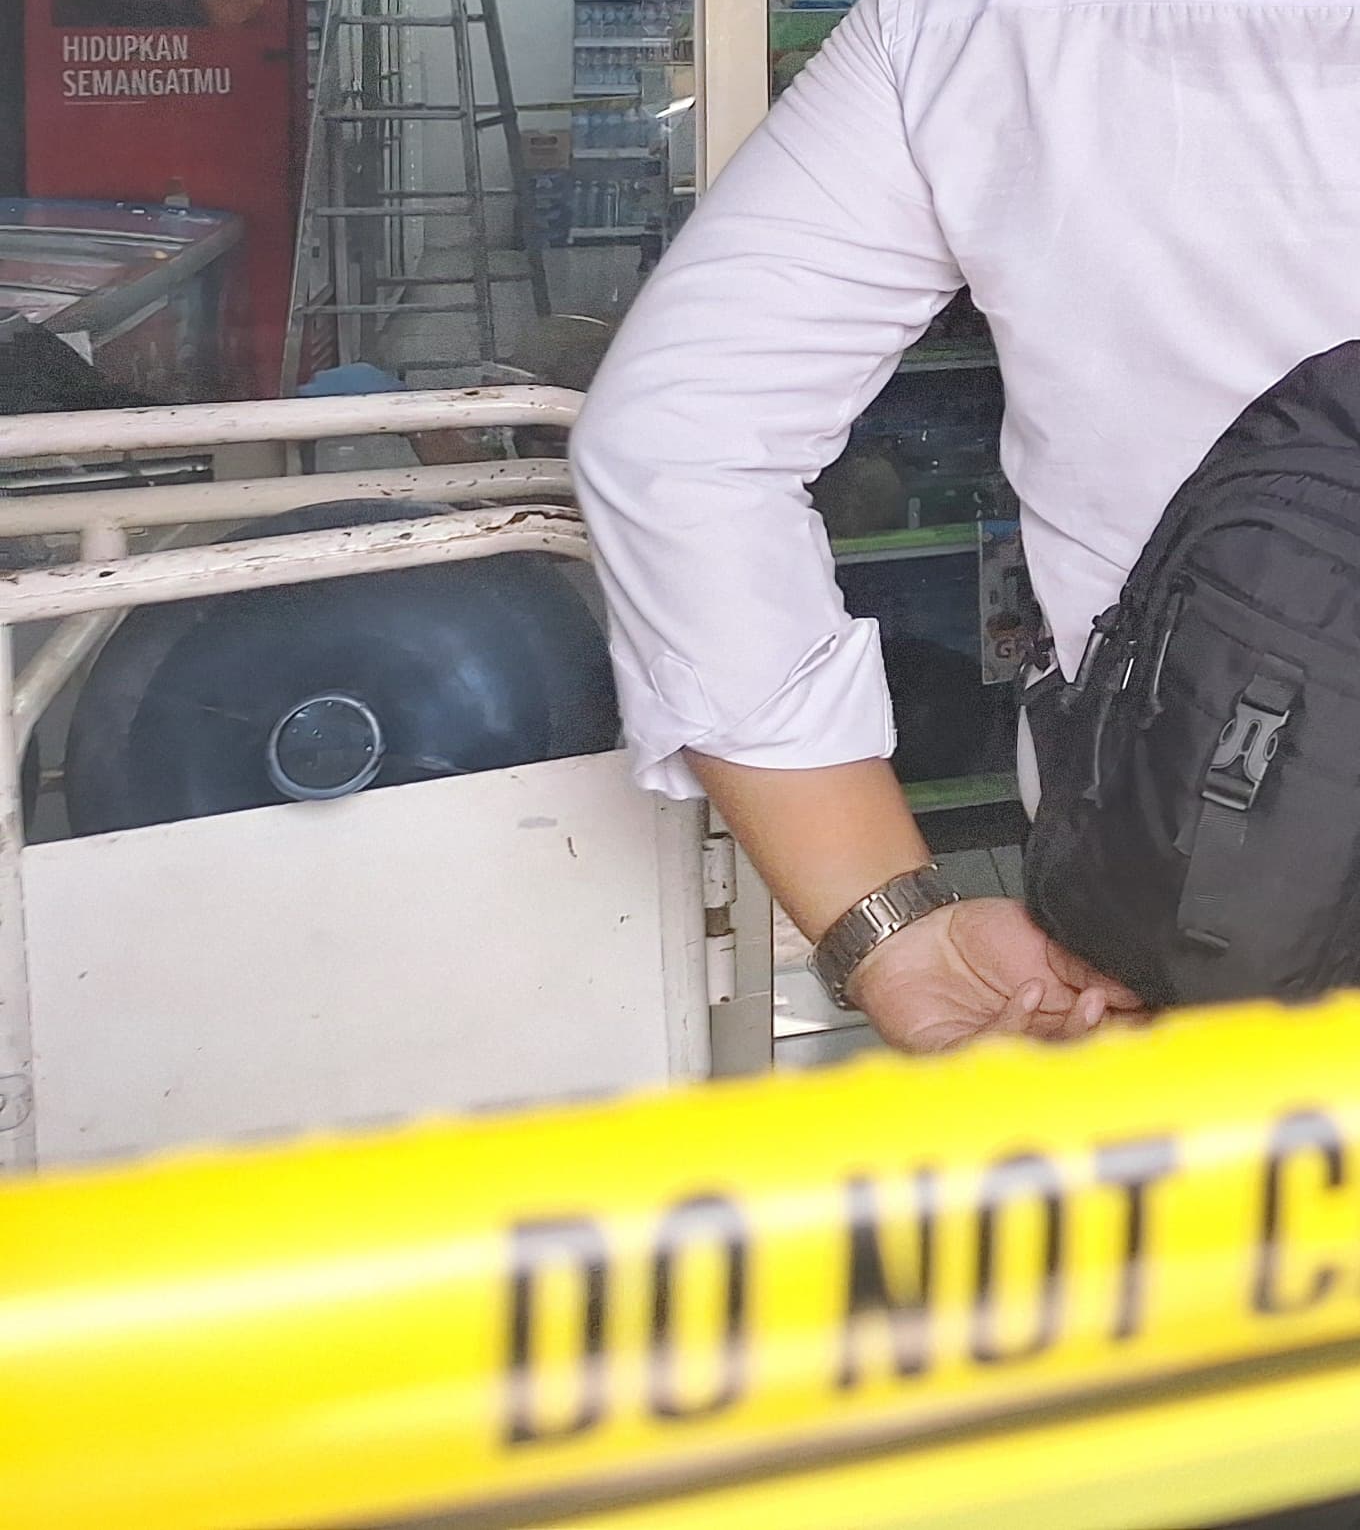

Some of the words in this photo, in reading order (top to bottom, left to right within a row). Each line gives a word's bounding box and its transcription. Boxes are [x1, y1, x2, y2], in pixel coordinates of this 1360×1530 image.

[62, 34, 189, 62] HIDUPKAN
[62, 68, 231, 98] SEMANGATMU
[498, 1186, 756, 1448] DO
[834, 1132, 1184, 1392] NOT
